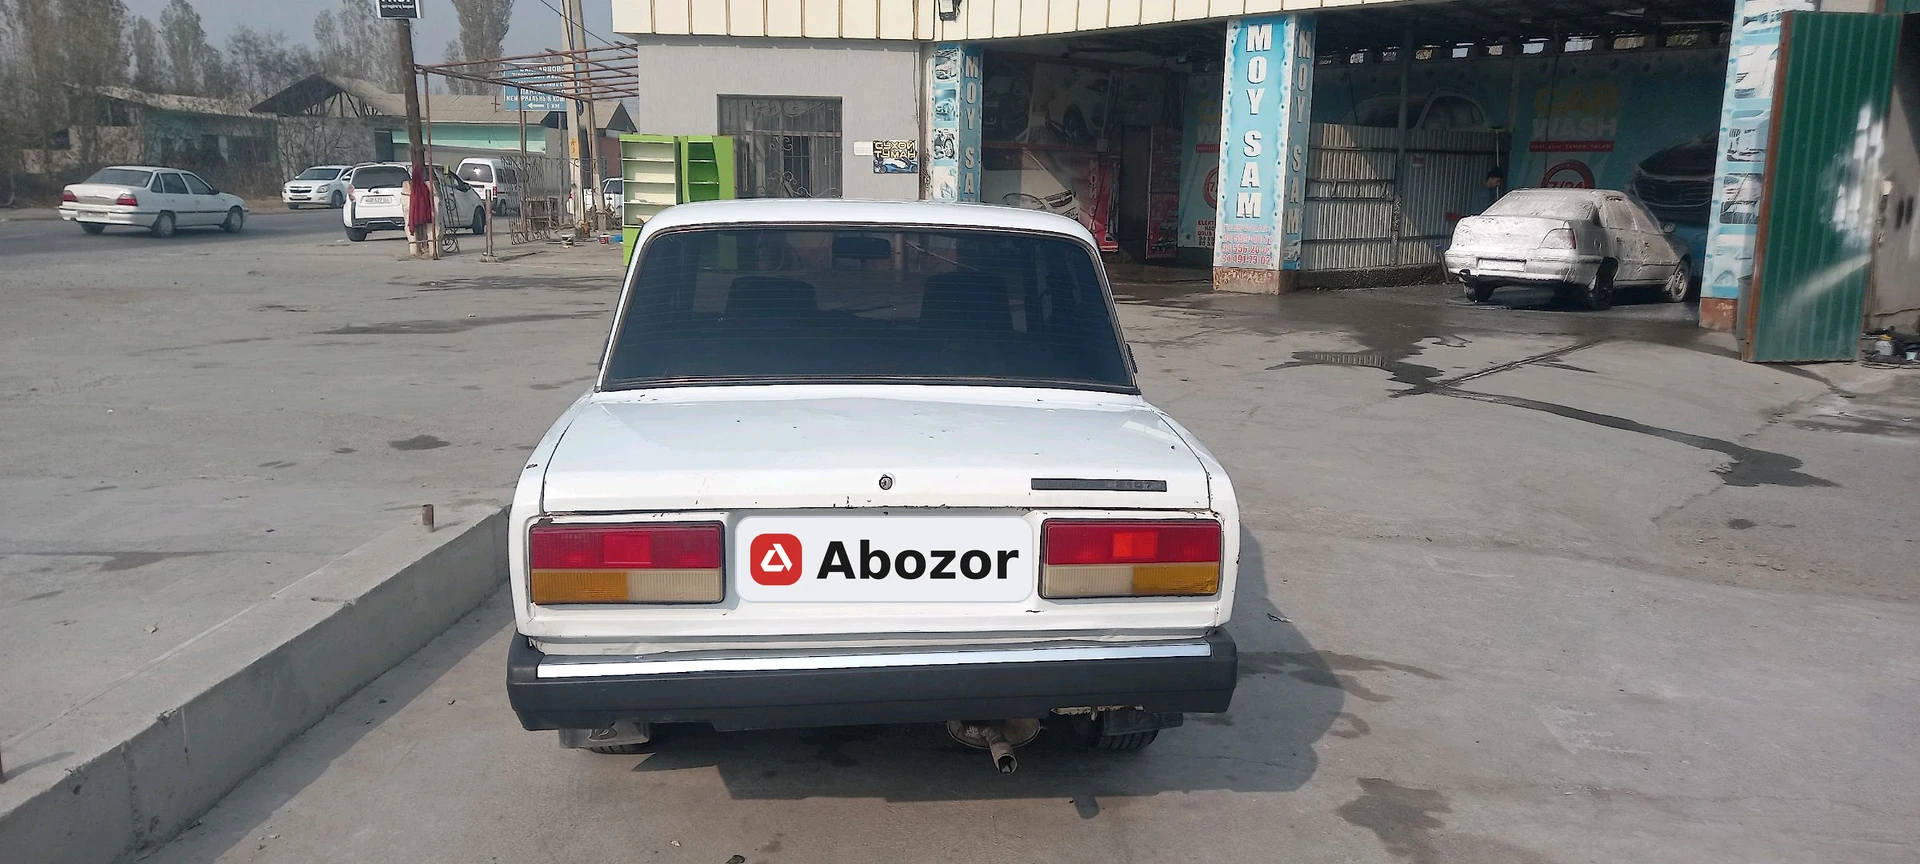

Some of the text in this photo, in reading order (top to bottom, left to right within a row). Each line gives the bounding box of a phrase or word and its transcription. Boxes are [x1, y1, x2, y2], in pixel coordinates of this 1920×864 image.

[1246, 23, 1273, 115] MOY
[874, 140, 915, 150] СУХОЙ
[874, 150, 916, 159] ТУМАН
[964, 55, 979, 203] MOY SA
[1286, 30, 1312, 235] MOY SAM
[1533, 116, 1618, 138] WASH
[1236, 130, 1262, 219] SAM
